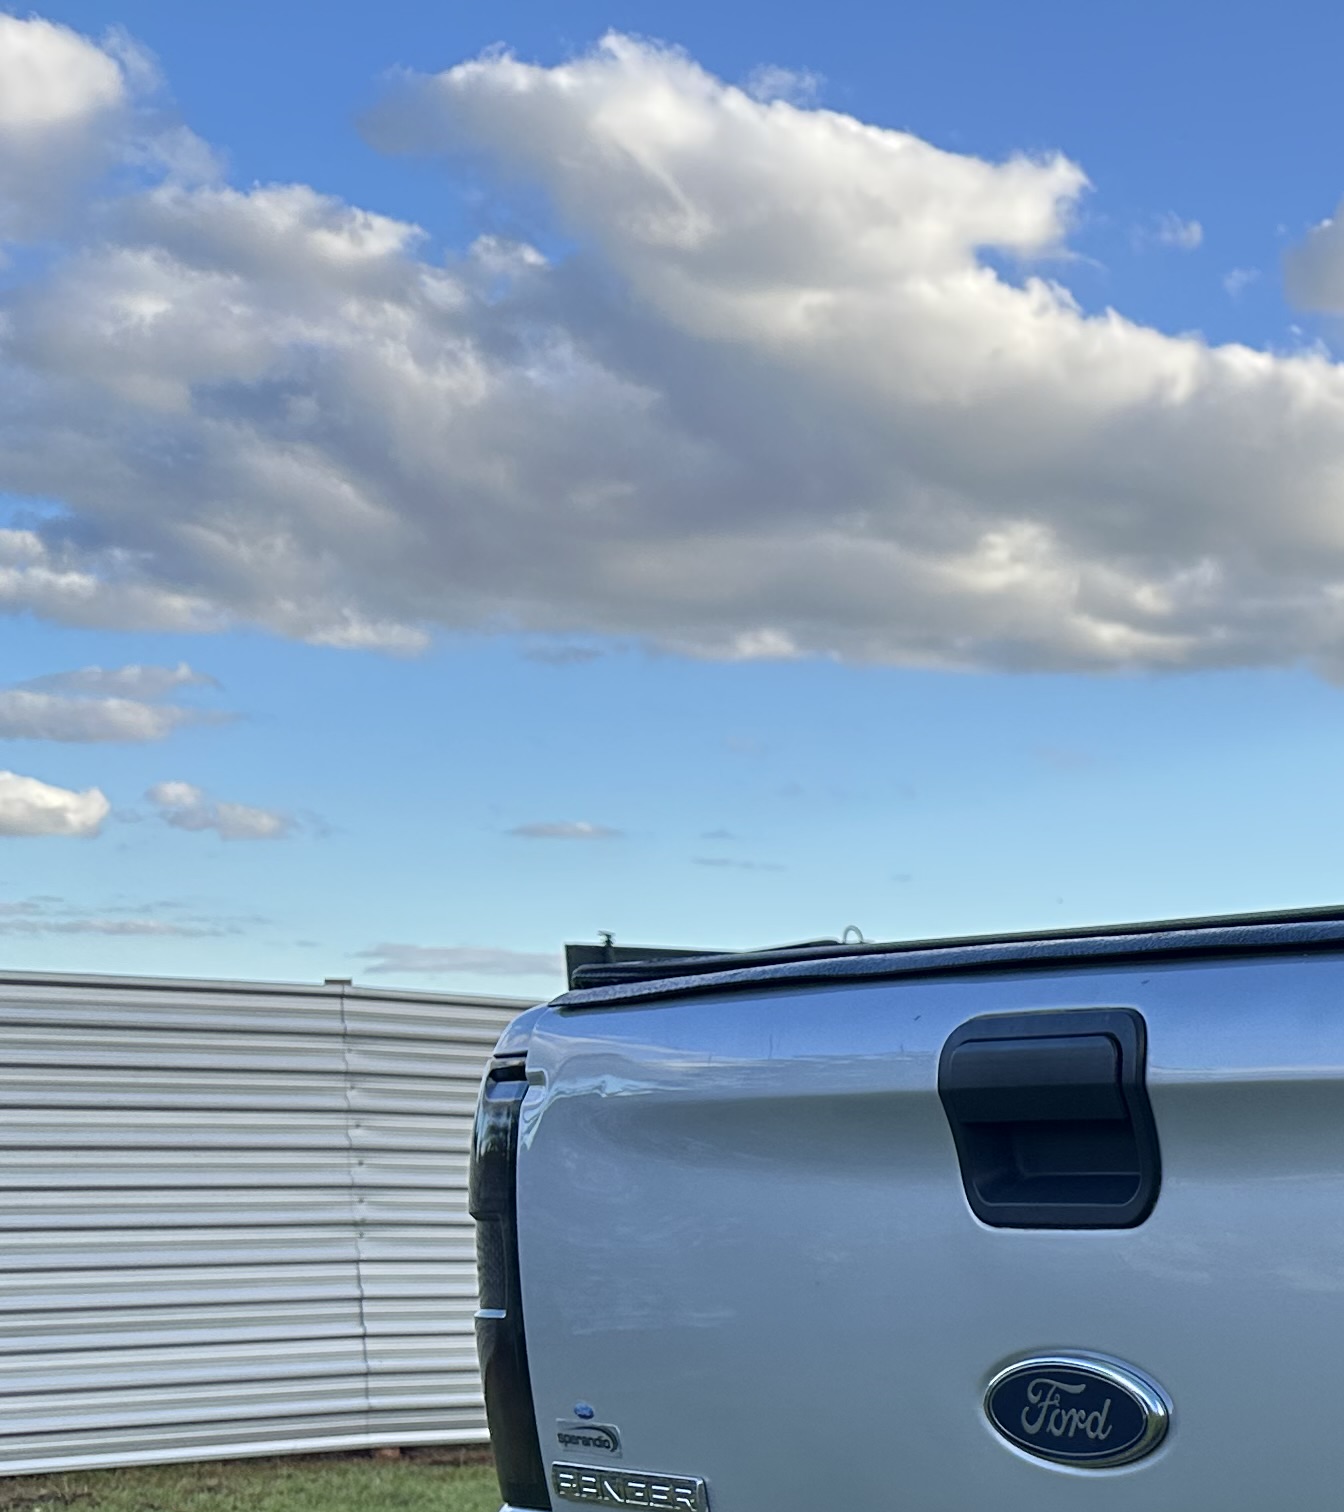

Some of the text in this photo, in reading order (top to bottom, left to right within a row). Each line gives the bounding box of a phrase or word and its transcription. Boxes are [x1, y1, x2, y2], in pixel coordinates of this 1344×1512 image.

[1021, 1377, 1113, 1441] Ford
[557, 1432, 612, 1450] sperandio
[557, 1472, 698, 1512] RANGER
